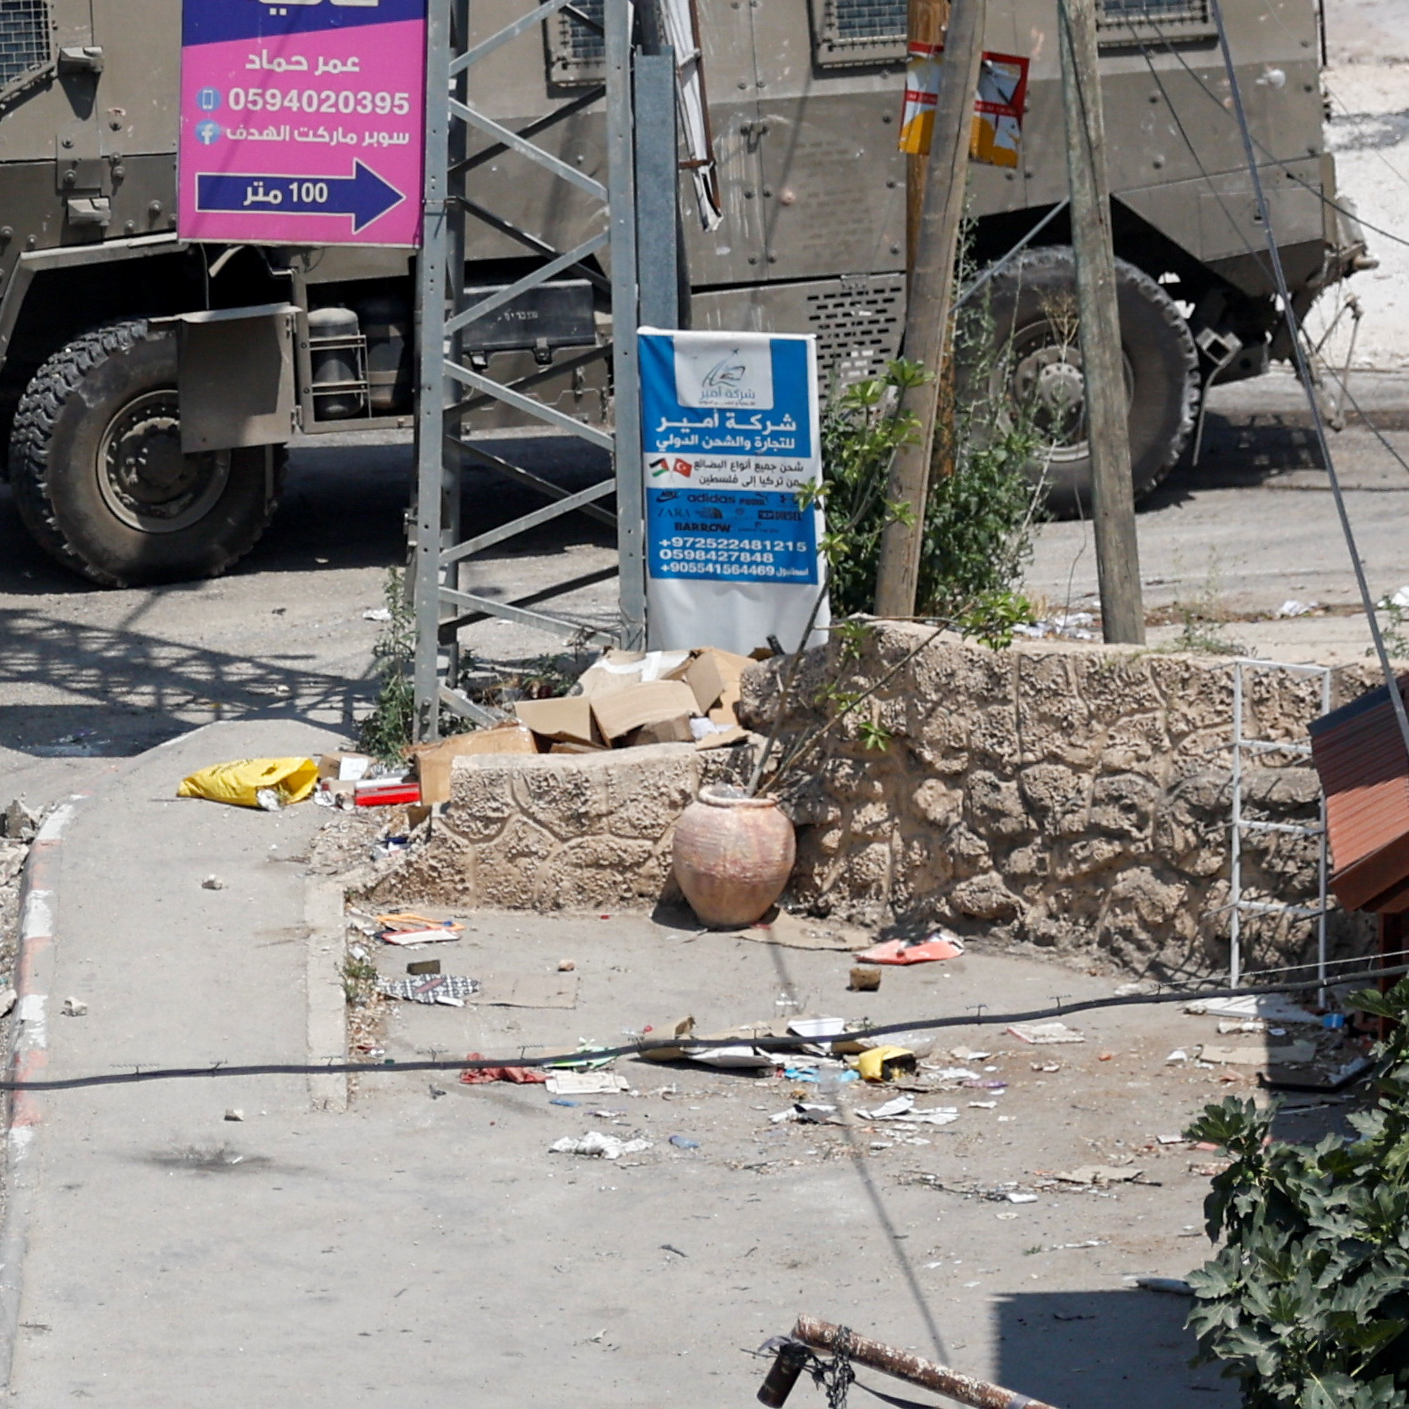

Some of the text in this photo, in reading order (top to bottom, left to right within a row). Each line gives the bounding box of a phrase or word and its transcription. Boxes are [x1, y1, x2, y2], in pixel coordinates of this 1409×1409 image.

[245, 49, 361, 77] عمر حماد
[227, 87, 411, 116] 0594020395
[225, 124, 410, 147] سوبر ماركت الهدف
[242, 179, 329, 207] 100 متر
[655, 408, 797, 435] شركة أمير
[655, 433, 795, 453] للتجارة والشحن الدولي
[754, 462, 777, 473] جميع
[779, 461, 804, 473] شحن
[687, 492, 736, 504] adidas
[674, 522, 731, 532] BARROW
[658, 537, 807, 552] +972522481215
[659, 549, 774, 563] 0598427848
